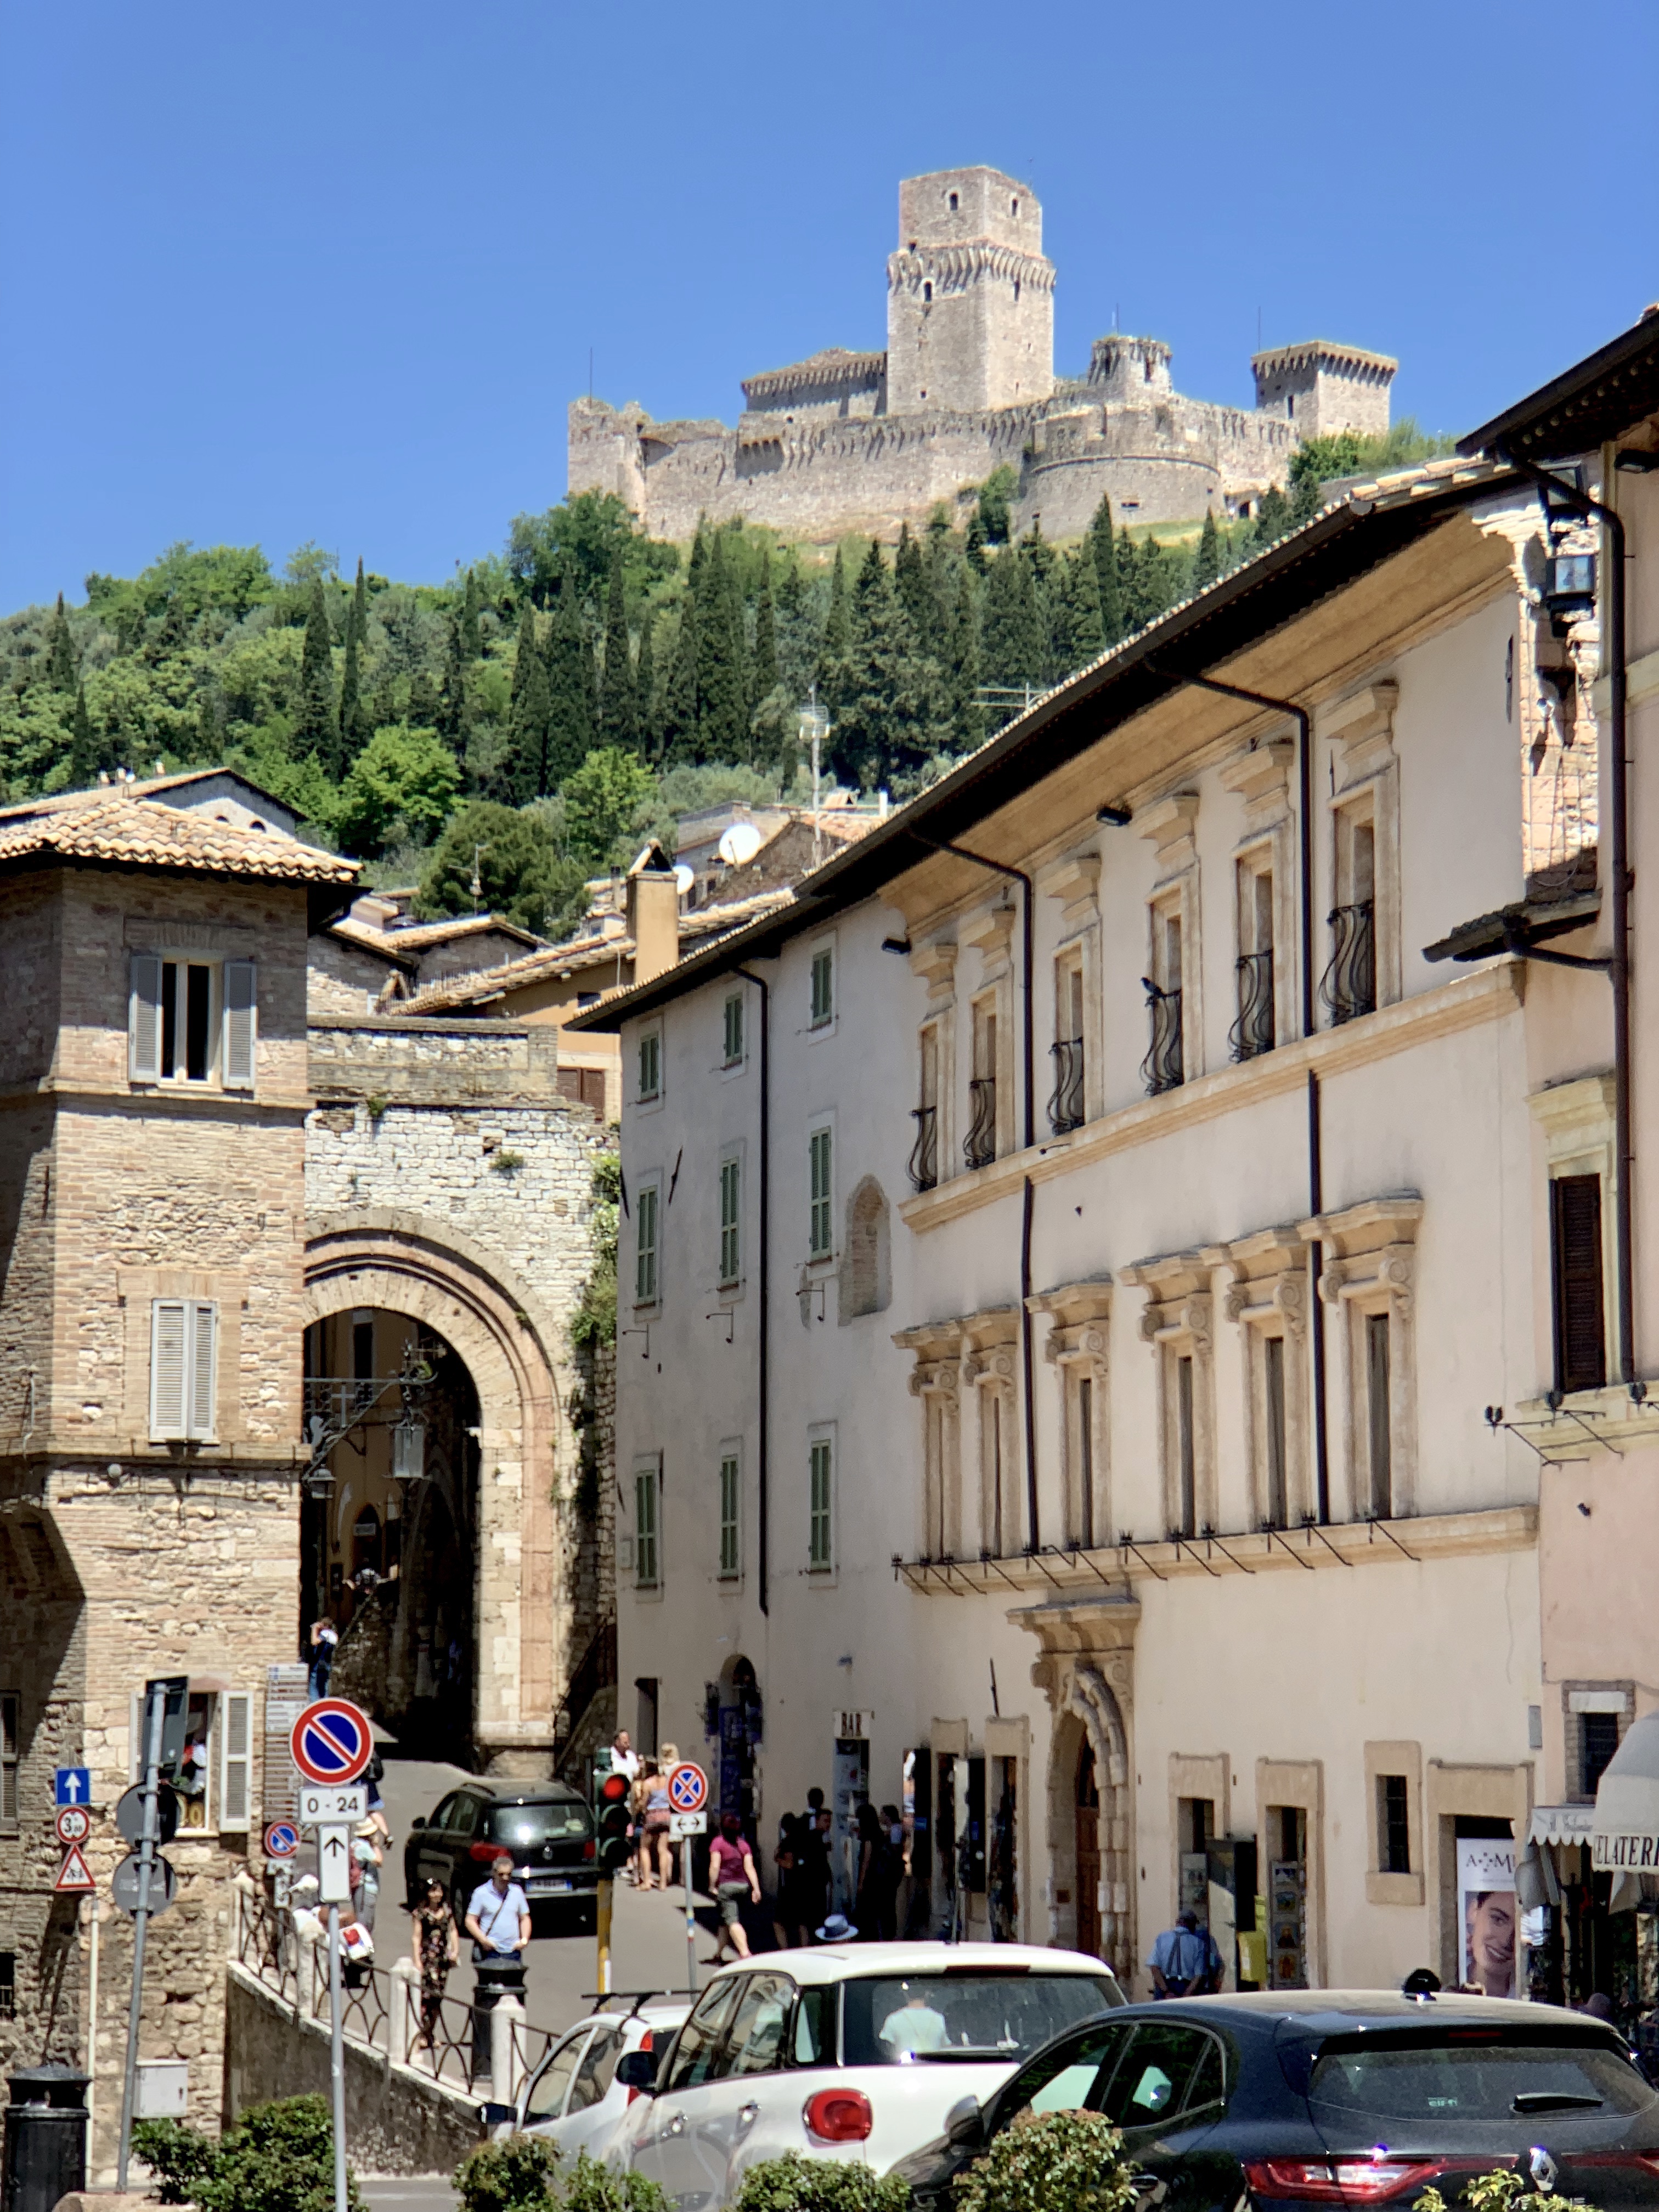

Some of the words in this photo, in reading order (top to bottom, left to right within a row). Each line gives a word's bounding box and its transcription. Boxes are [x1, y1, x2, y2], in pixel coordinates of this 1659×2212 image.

[841, 1712, 862, 1737] BAR
[307, 1797, 318, 1813] 0
[337, 1796, 358, 1812] 24
